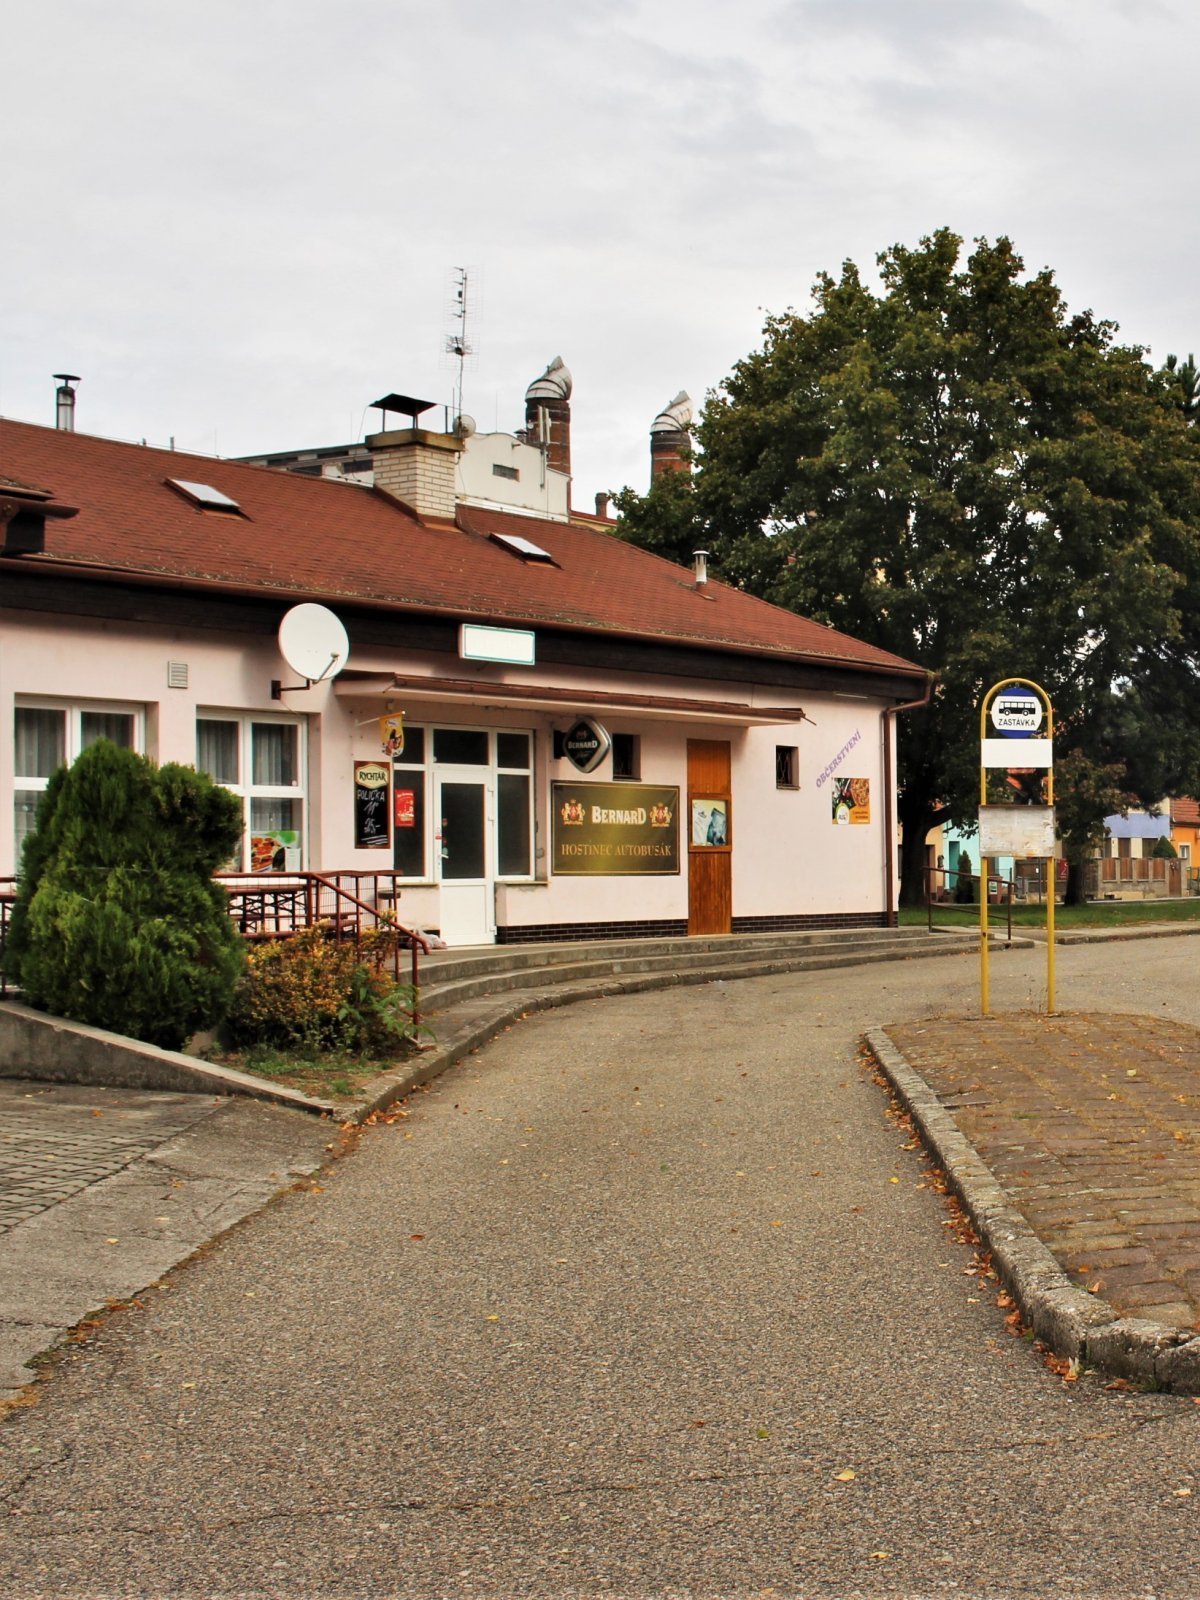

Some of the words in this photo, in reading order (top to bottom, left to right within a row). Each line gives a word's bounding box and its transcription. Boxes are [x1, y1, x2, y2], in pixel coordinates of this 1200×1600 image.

[998, 718, 1036, 727] ZASTÁVKA
[815, 728, 862, 789] OBČERSTVENÍ
[591, 805, 647, 825] BERNARD
[561, 843, 613, 856] HOSTINEC
[615, 842, 672, 857] AUTOBUSÁK
